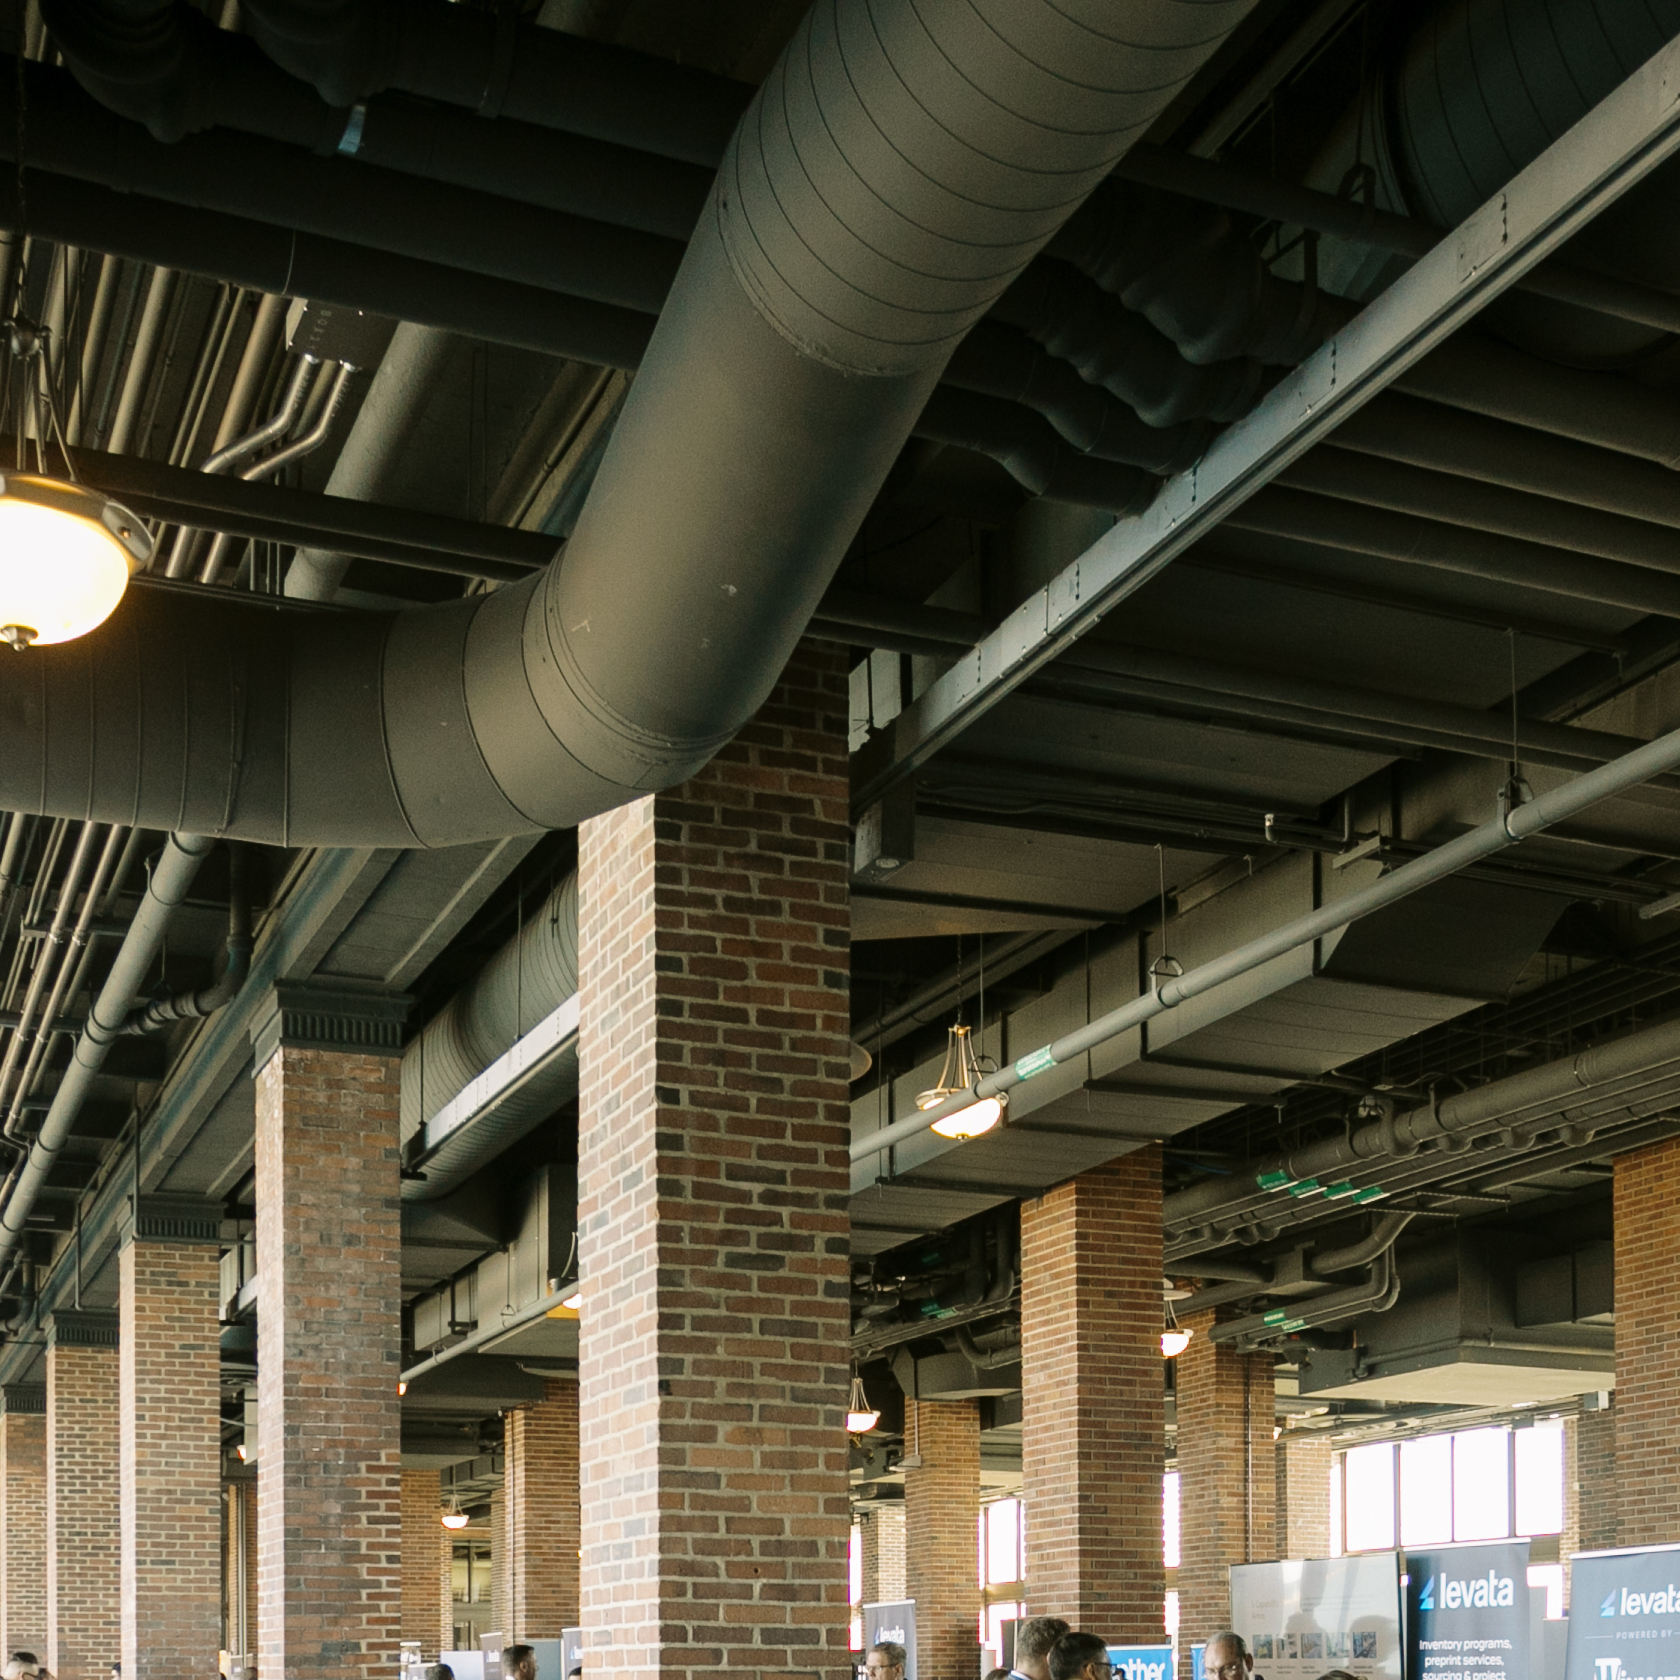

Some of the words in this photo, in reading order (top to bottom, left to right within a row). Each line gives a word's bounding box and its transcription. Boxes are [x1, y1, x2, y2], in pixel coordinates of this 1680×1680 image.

[1440, 1569, 1514, 1609] levata
[880, 1625, 905, 1644] levata
[1616, 1630, 1658, 1640] POWERED
[1661, 1629, 1673, 1638] BY
[1419, 1640, 1462, 1652] Inventory
[1463, 1639, 1512, 1652] programs,
[1424, 1655, 1462, 1668] preprint
[1462, 1654, 1504, 1667] services,
